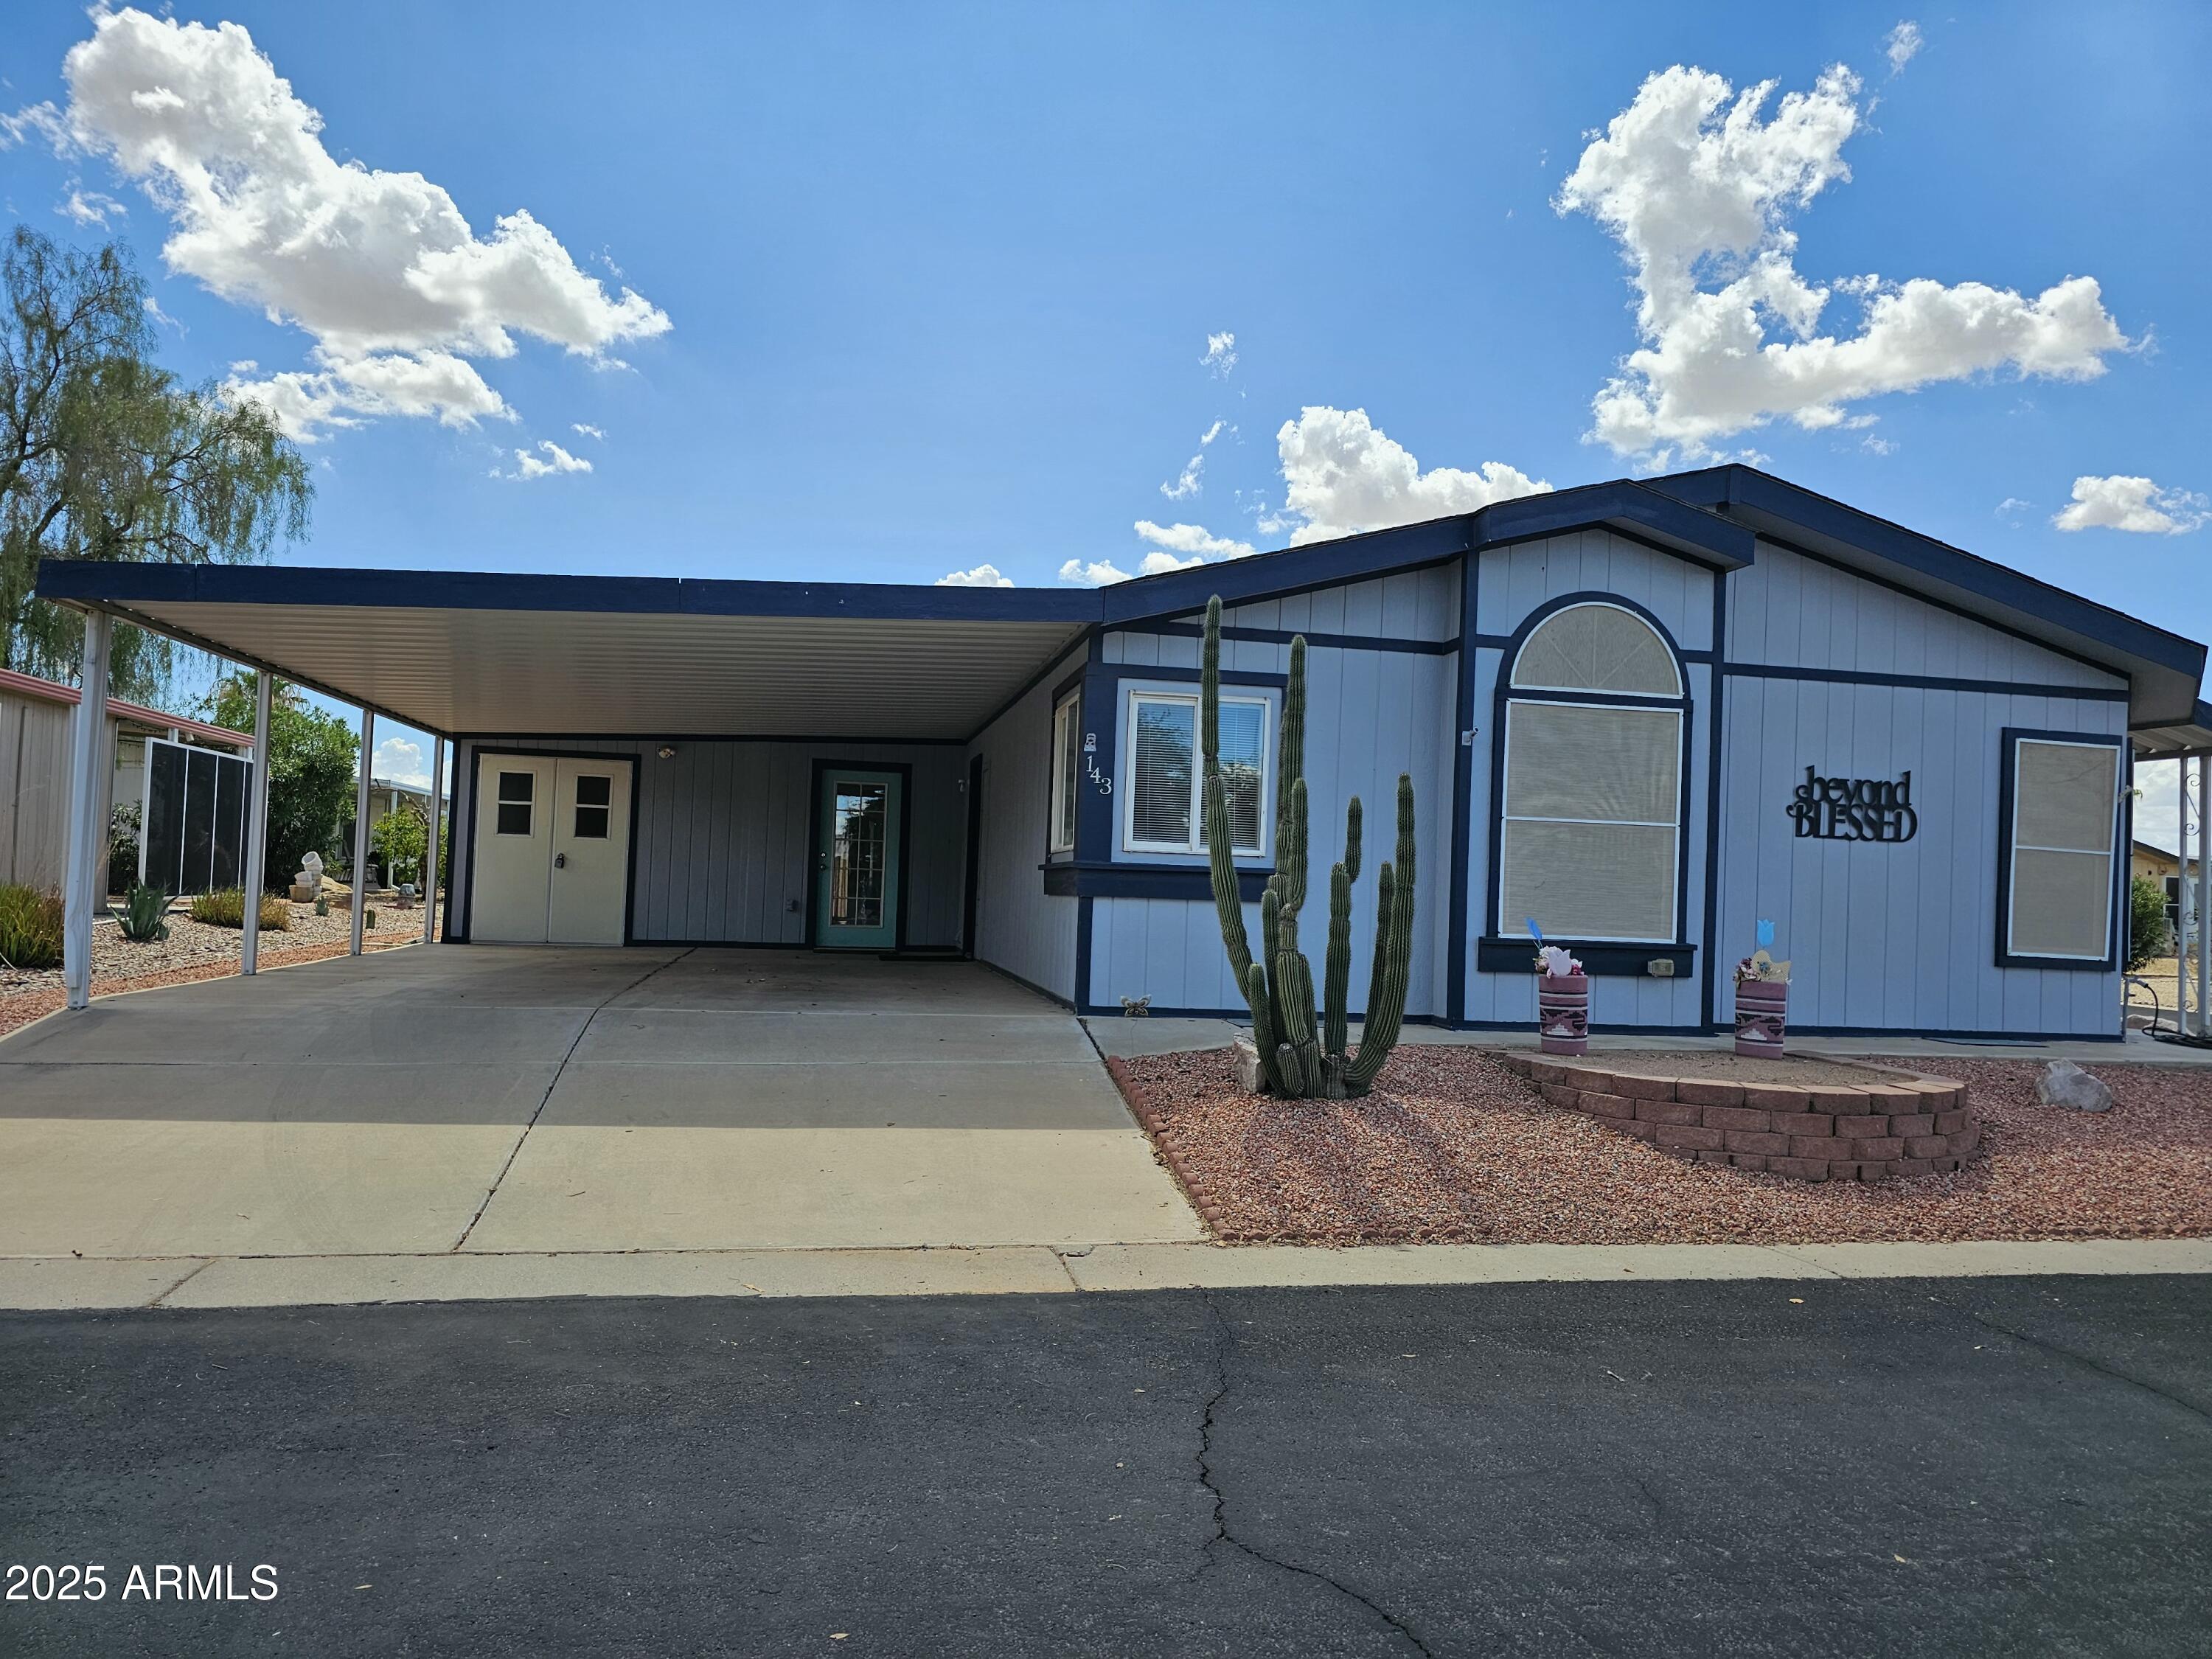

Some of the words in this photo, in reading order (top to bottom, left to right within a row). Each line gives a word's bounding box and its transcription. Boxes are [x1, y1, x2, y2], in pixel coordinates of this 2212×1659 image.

[1085, 754, 1112, 795] 143
[1795, 765, 1912, 808] beyond
[1786, 800, 1918, 842] BLESSED
